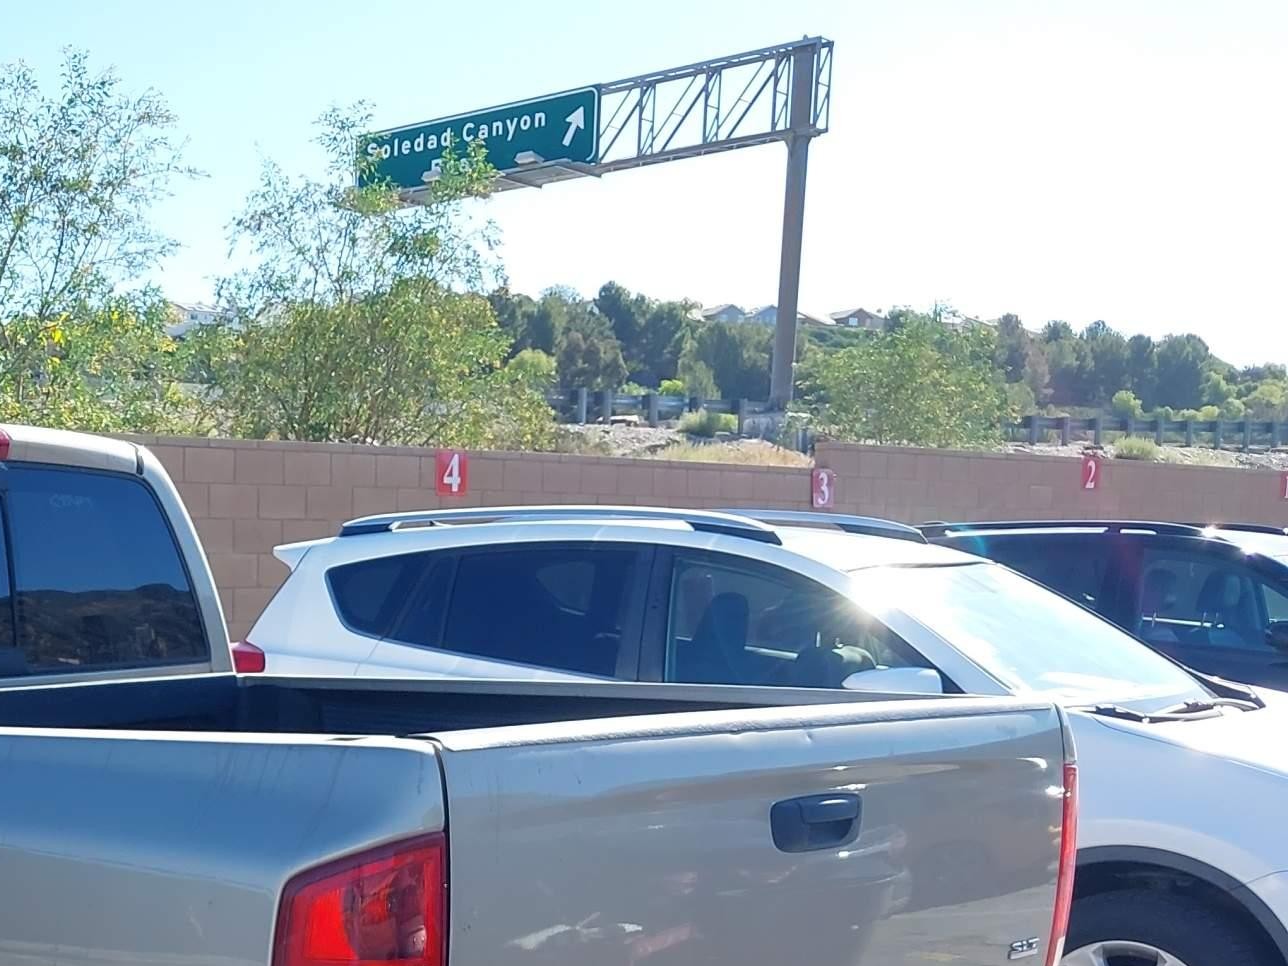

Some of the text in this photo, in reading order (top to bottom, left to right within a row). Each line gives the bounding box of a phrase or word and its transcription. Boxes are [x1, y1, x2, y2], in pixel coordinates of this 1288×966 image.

[366, 111, 546, 160] Soledad Canyon
[443, 453, 461, 493] 4
[818, 472, 829, 505] 3
[1085, 460, 1096, 489] 2
[1010, 937, 1040, 952] SLT
